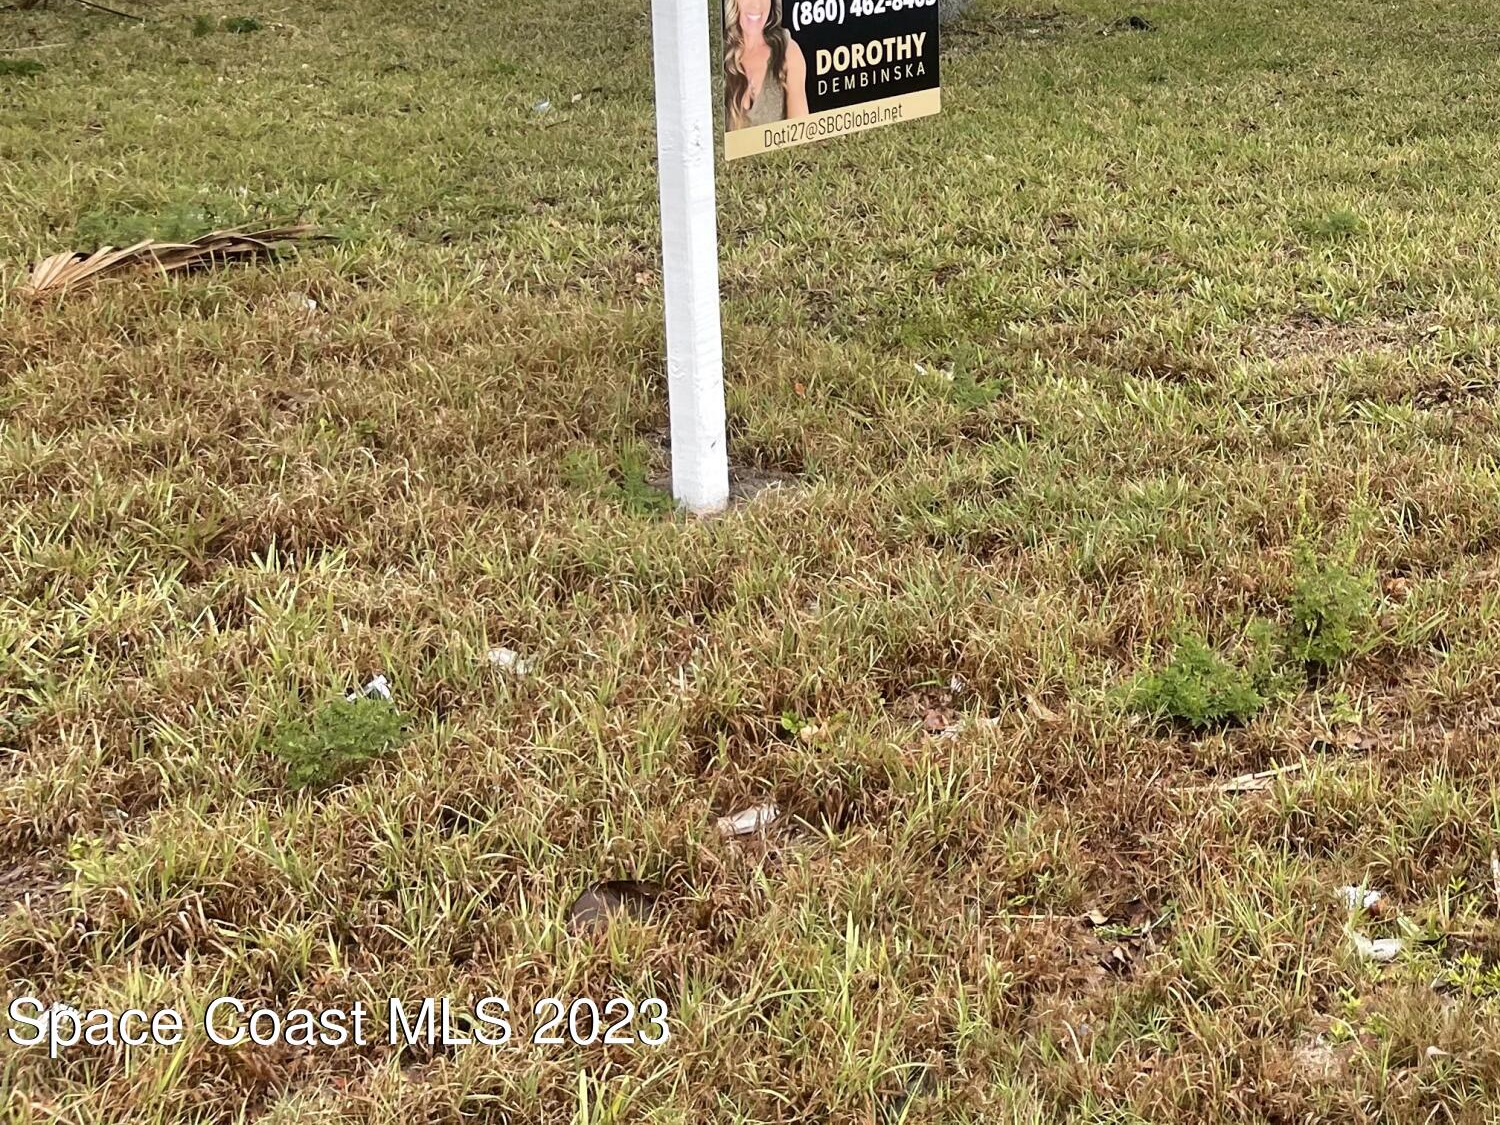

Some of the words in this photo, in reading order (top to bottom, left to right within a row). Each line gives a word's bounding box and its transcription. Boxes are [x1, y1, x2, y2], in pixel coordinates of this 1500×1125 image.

[816, 31, 927, 75] DOROTHY
[817, 61, 926, 95] DEMBINSKA
[764, 103, 903, 149] Doti27@SBCGlobal.net
